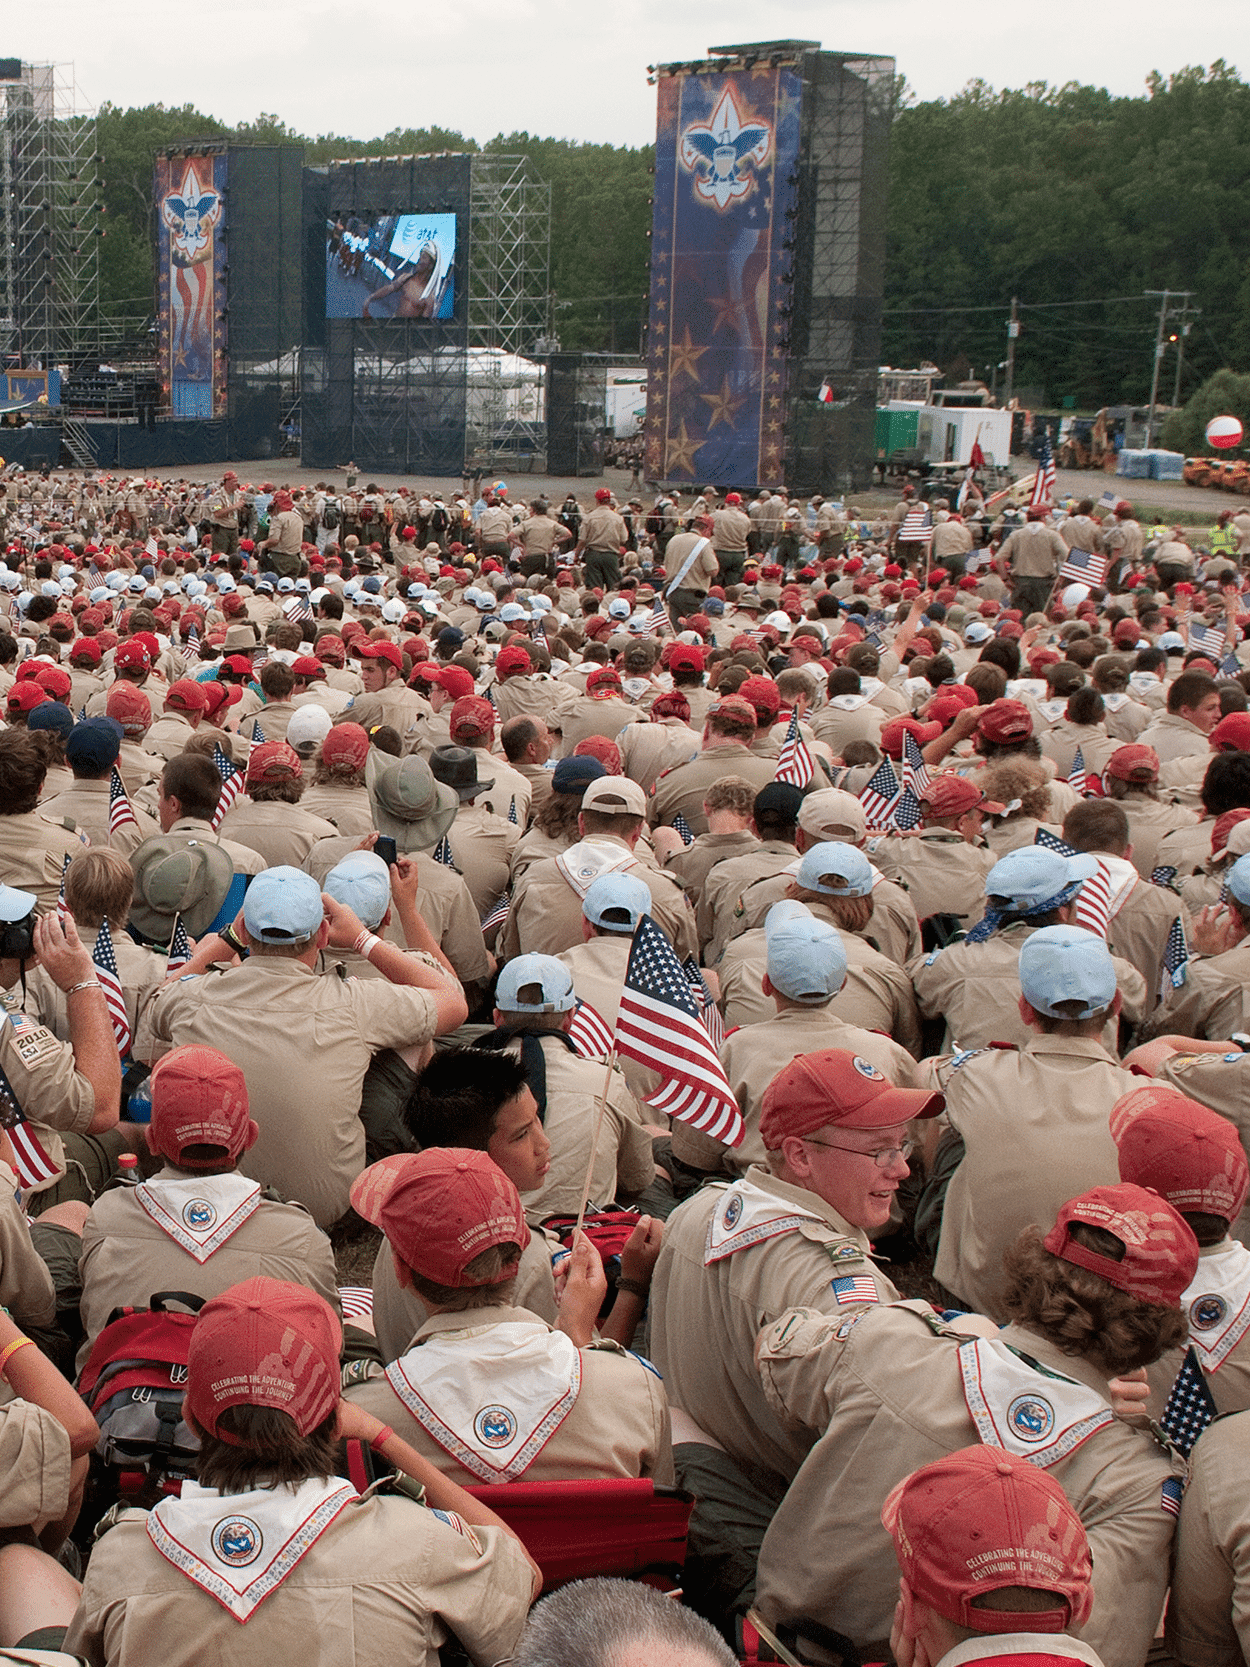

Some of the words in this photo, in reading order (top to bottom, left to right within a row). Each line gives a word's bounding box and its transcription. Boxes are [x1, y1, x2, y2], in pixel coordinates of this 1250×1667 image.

[17, 1029, 48, 1049] 2010
[211, 1374, 247, 1393] CELEBRATING
[249, 1374, 261, 1384] THE
[262, 1375, 297, 1393] ADVENTURE
[213, 1385, 250, 1402] CONTINUING
[251, 1385, 264, 1395] THE
[265, 1386, 295, 1402] JOURNEY
[246, 1560, 283, 1599] NEBRASKA
[286, 1524, 313, 1555] NEVADA
[251, 1580, 274, 1604] SOUTH
[274, 1547, 304, 1582] CAROLINA
[307, 1518, 328, 1542] SOUTH
[965, 1547, 1014, 1569] CELEBRATING
[1015, 1547, 1029, 1559] THE
[1030, 1549, 1065, 1573] ADVENTURE
[971, 1561, 1017, 1581] CONTINUING
[1019, 1560, 1033, 1571] THE
[1035, 1562, 1061, 1581] JOURNEY
